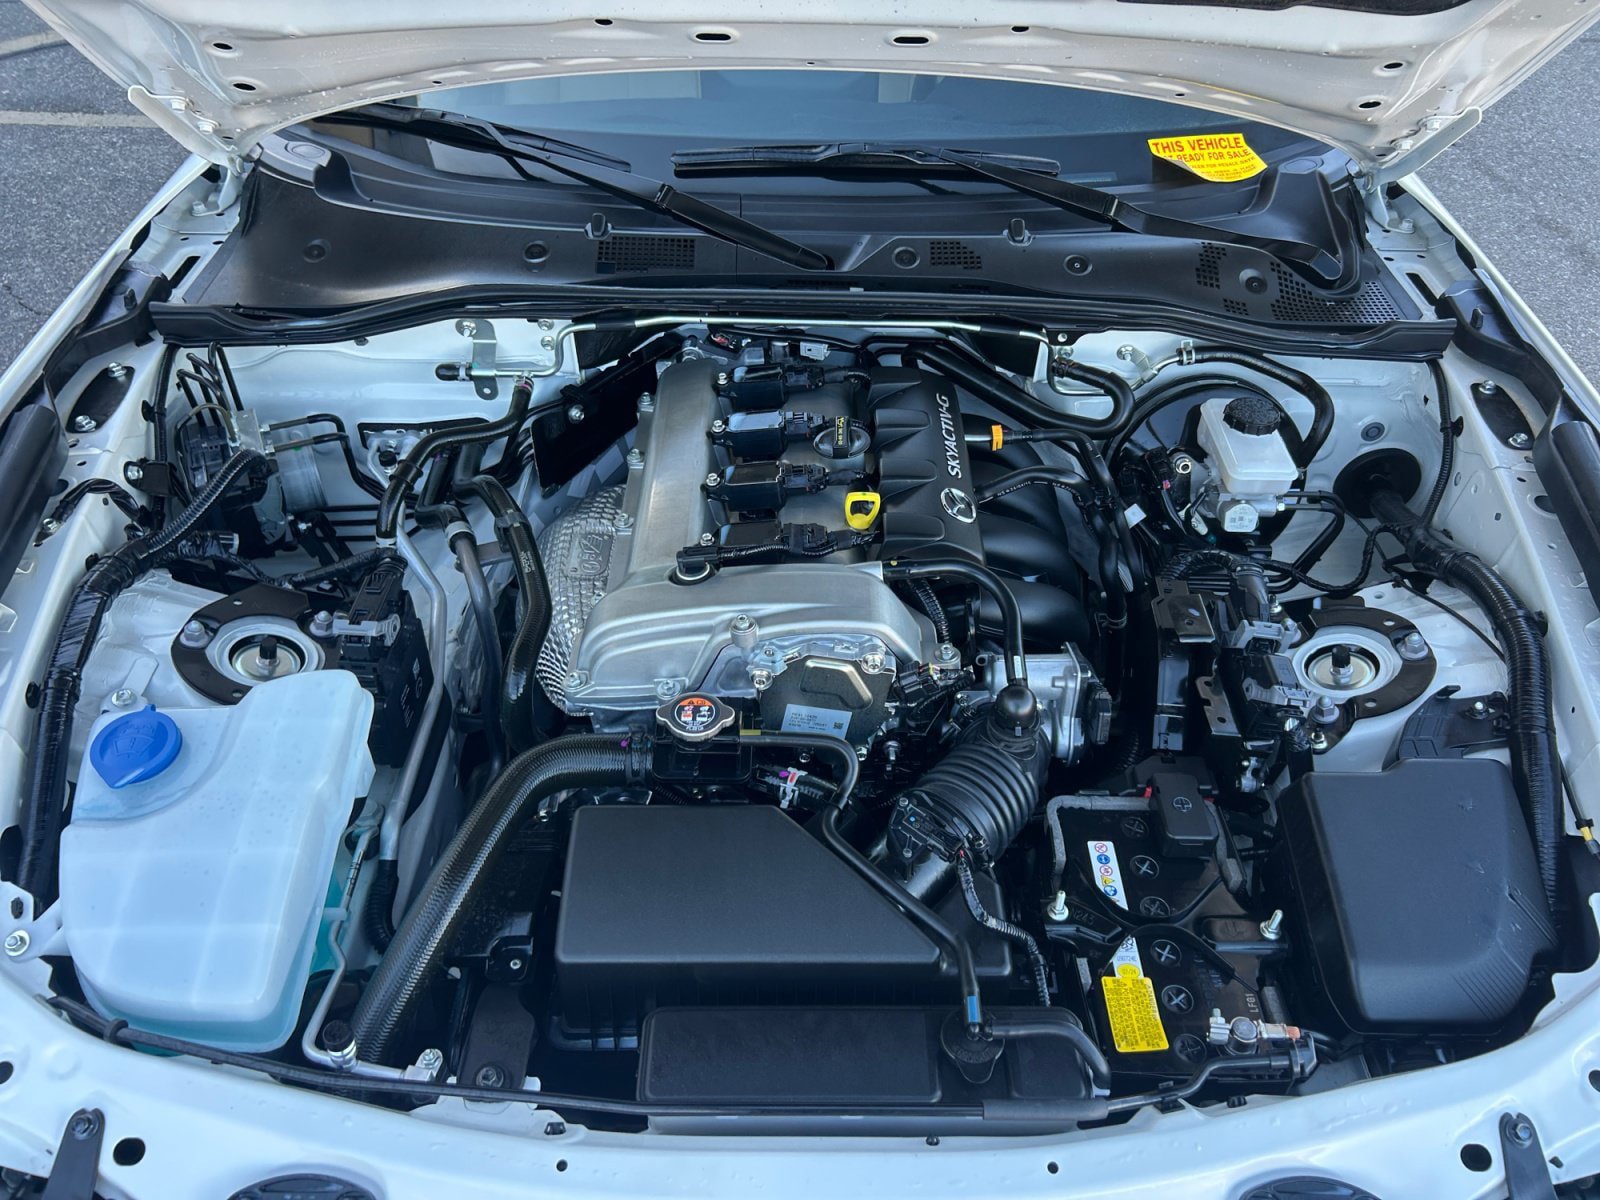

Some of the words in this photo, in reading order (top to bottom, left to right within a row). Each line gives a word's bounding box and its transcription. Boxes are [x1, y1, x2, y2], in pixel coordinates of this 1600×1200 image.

[1152, 140, 1185, 154] THIS
[1187, 137, 1244, 151] VEHICLE
[1177, 151, 1205, 163] READY
[1208, 151, 1225, 161] FOR
[1227, 148, 1251, 160] SALE
[936, 393, 962, 478] SKYACTIV-G
